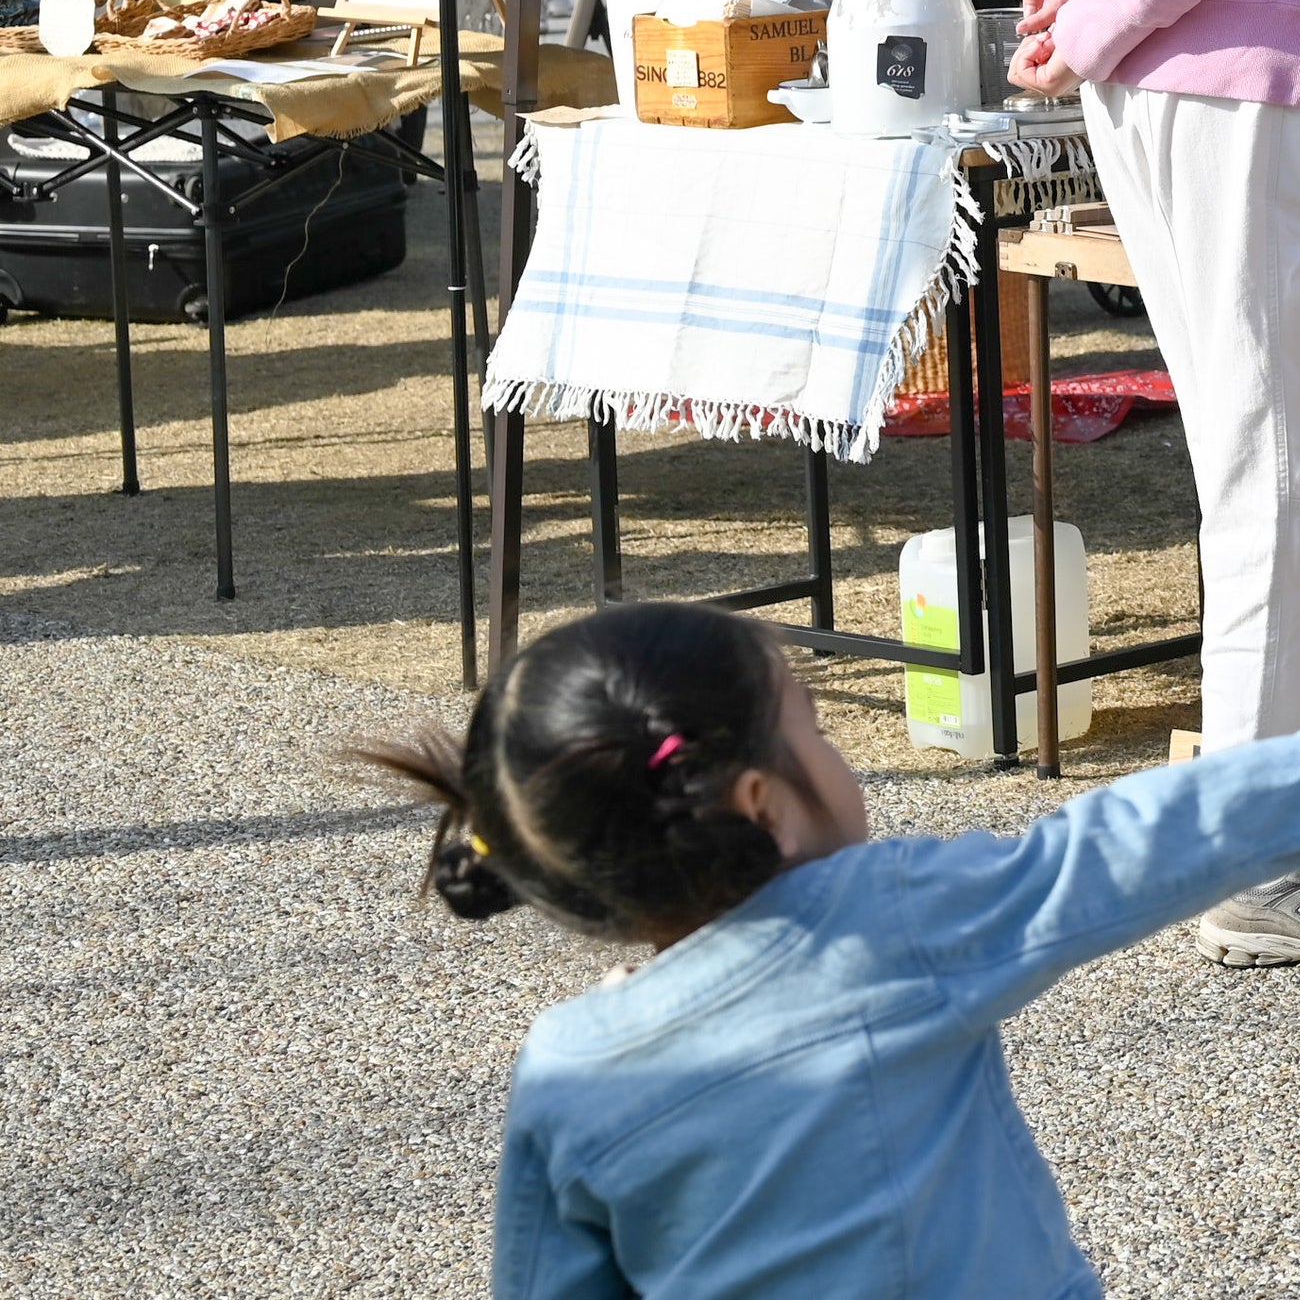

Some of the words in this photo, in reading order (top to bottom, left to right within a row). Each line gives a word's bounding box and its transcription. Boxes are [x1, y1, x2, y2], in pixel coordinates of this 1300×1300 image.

[750, 18, 819, 41] SAMUEL
[886, 64, 915, 77] 618
[698, 71, 726, 89] 882
